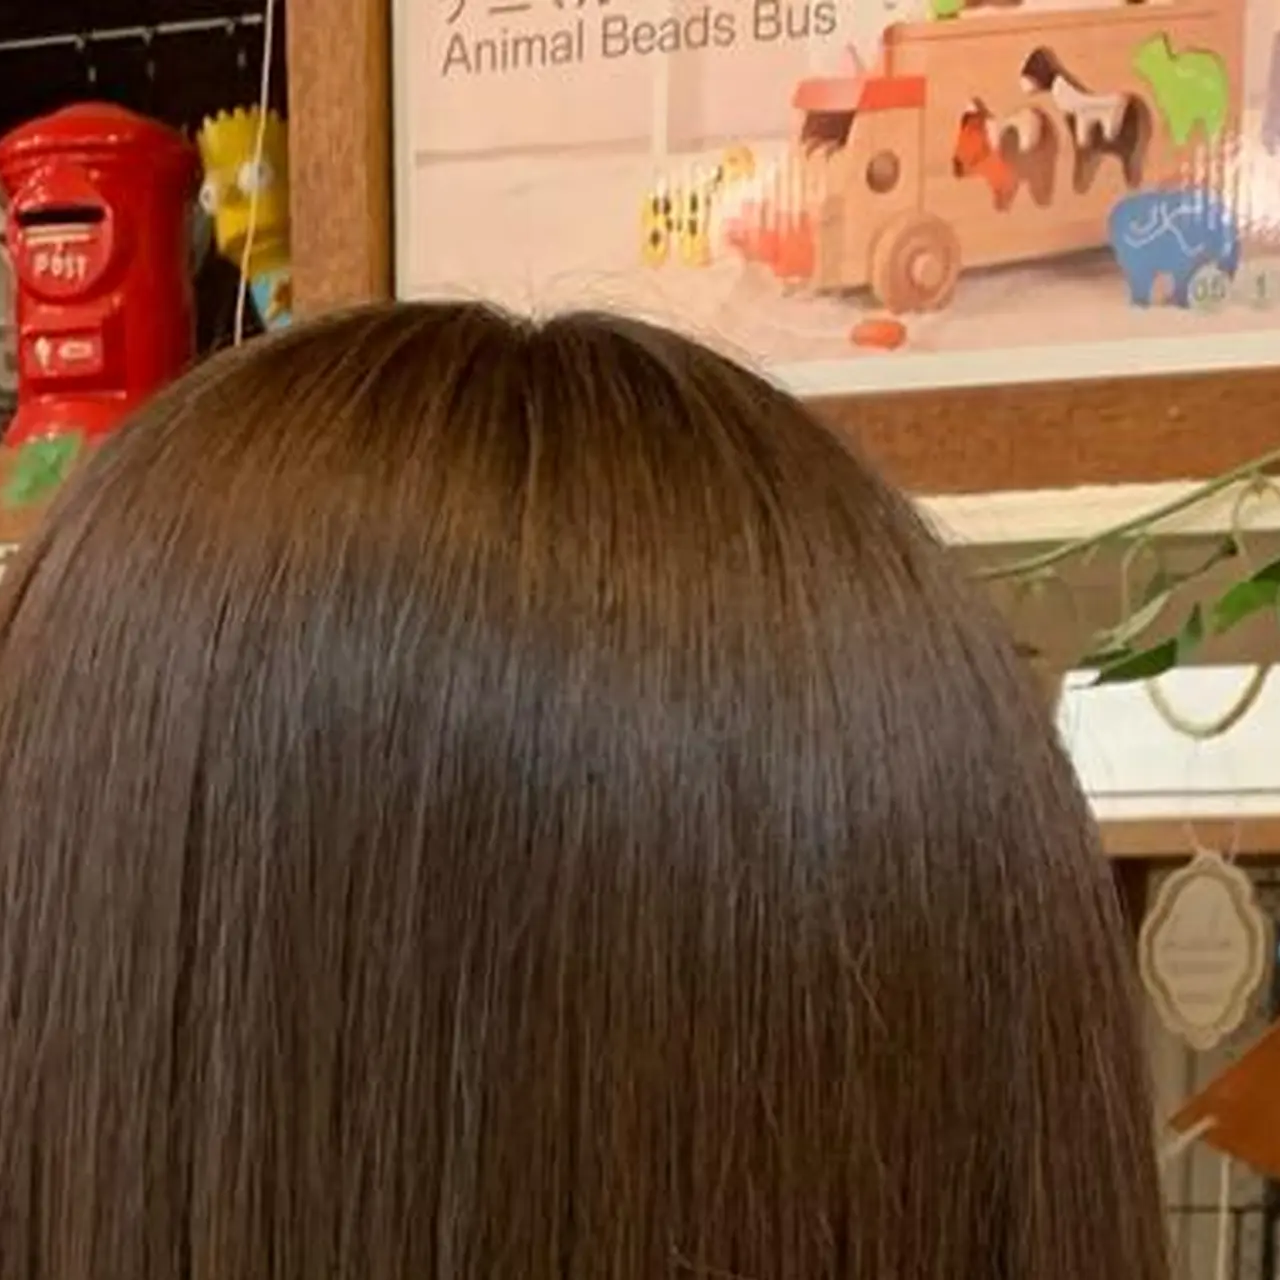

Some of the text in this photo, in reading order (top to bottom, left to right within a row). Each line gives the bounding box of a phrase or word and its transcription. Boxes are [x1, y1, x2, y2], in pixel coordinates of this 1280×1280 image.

[441, 21, 585, 76] Animal
[601, 7, 736, 58] Beads
[753, 0, 837, 42] Bus
[33, 253, 87, 280] POST
